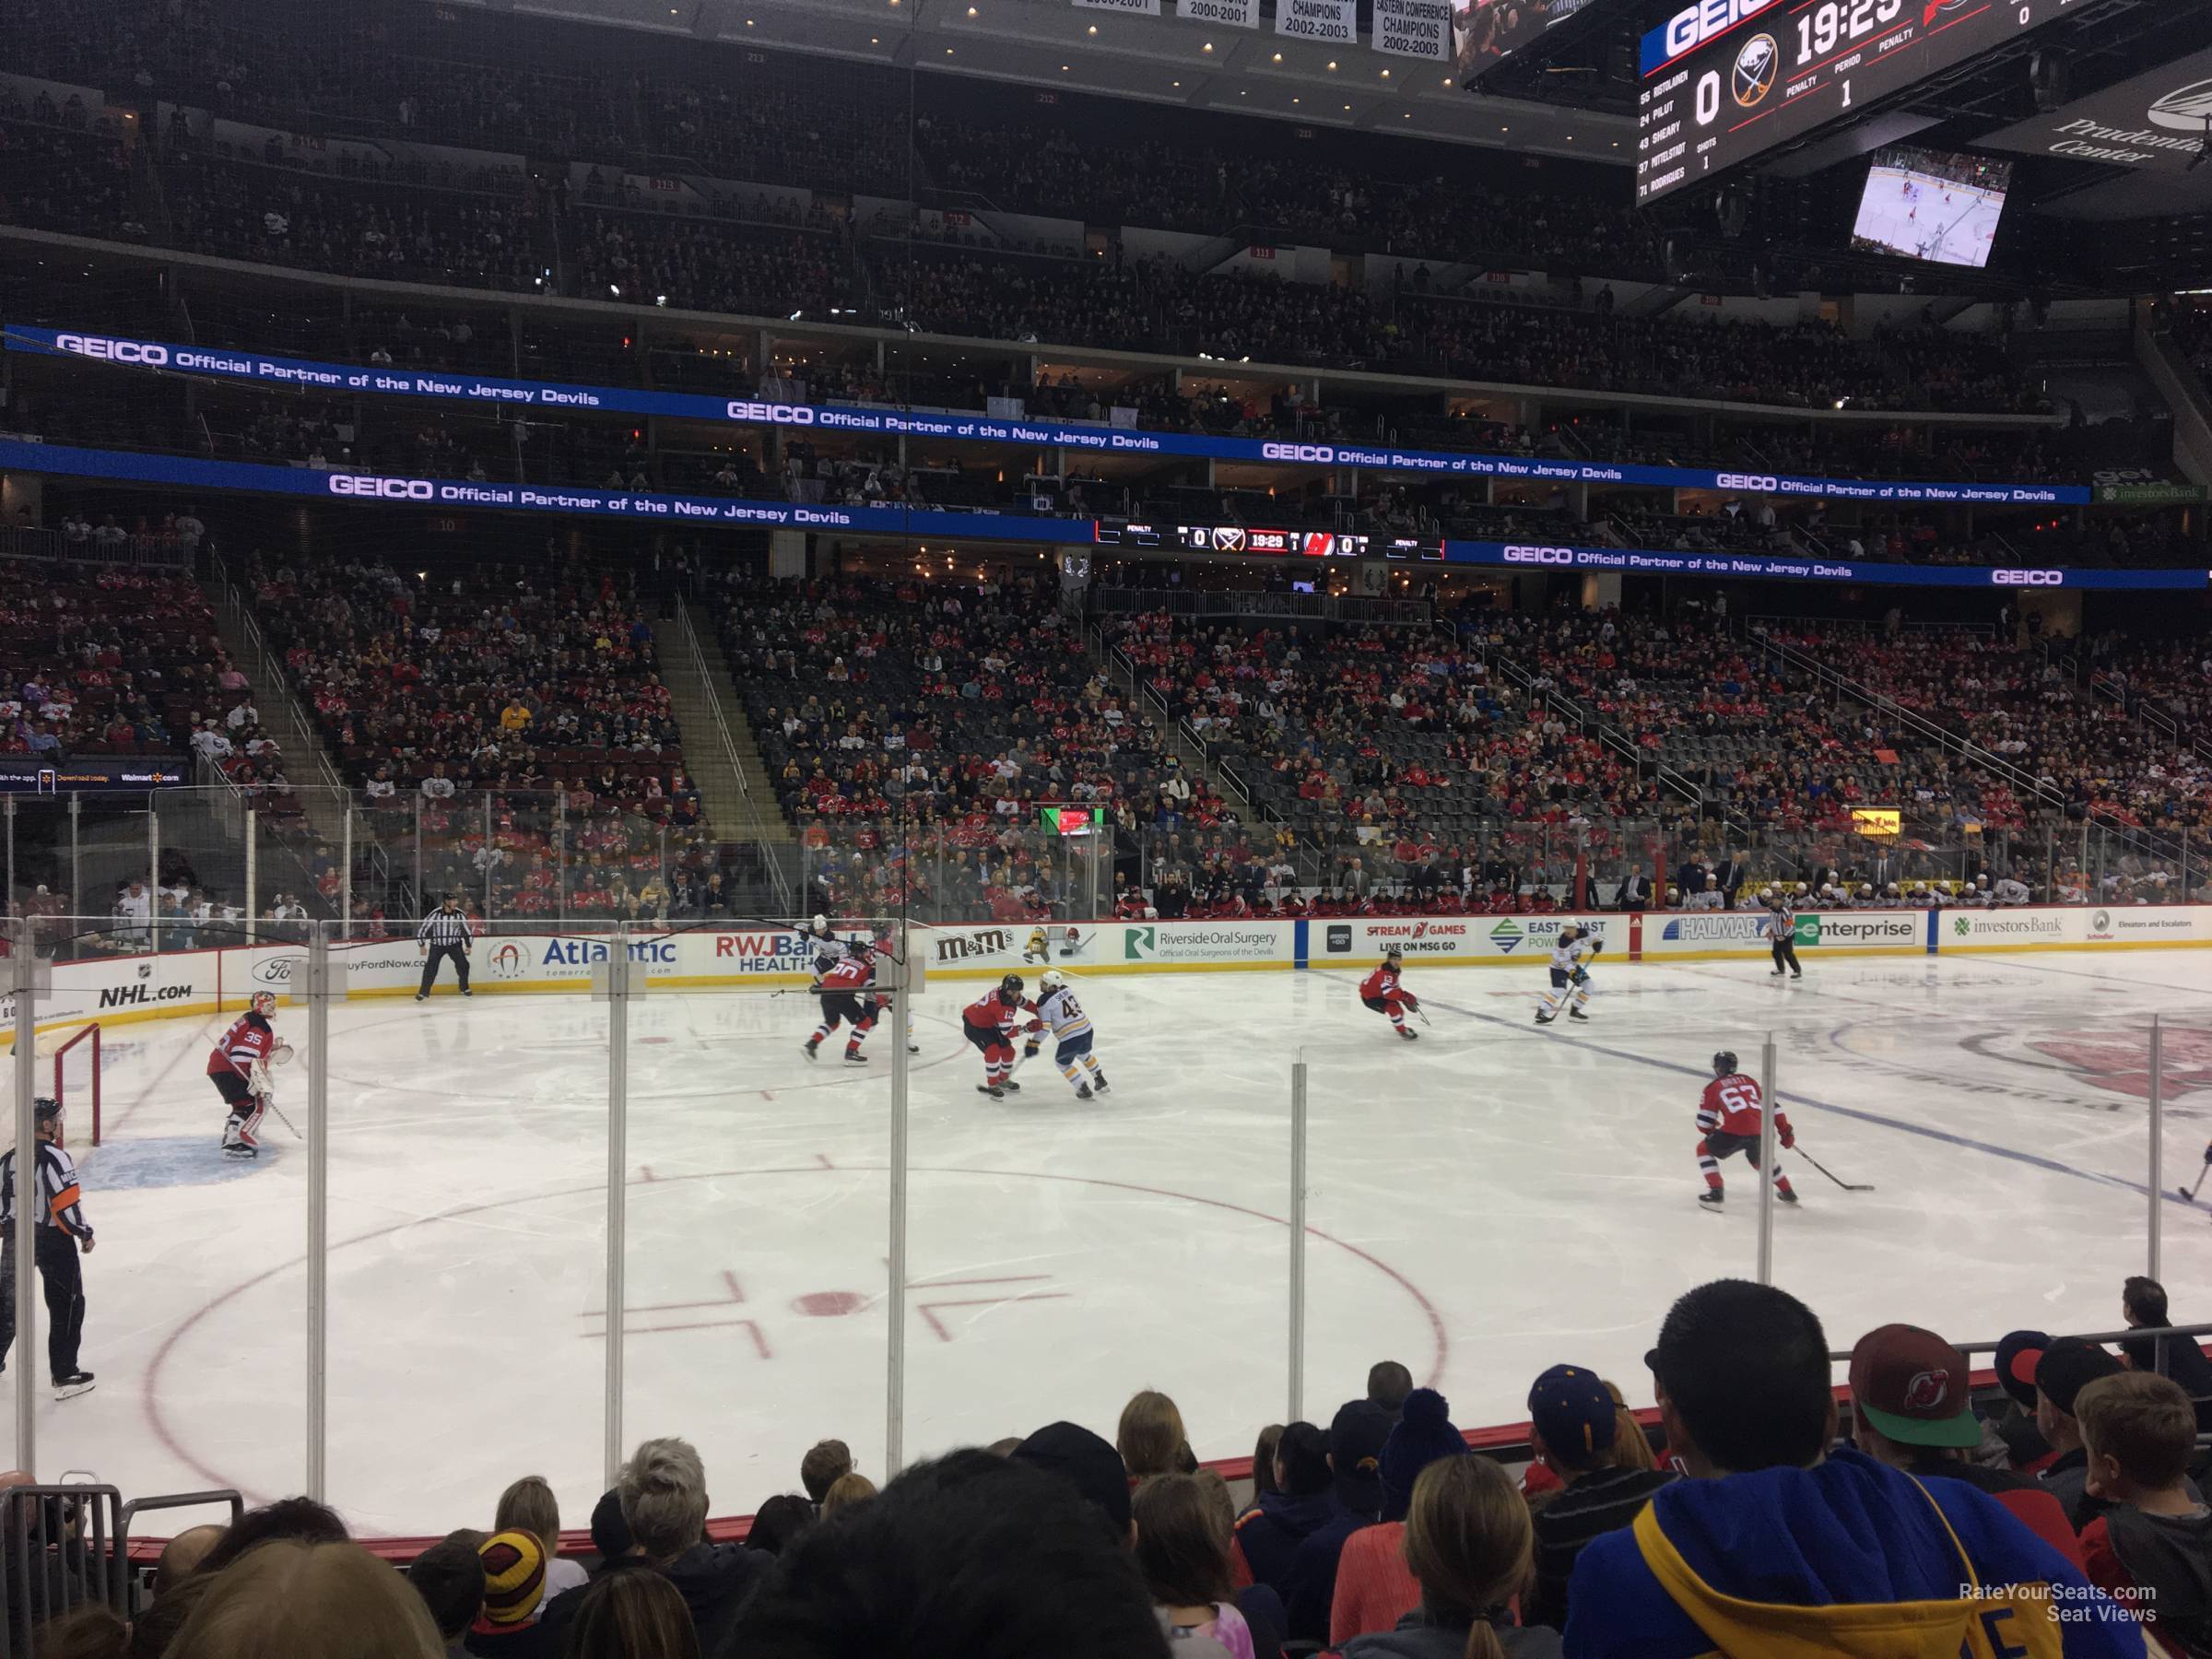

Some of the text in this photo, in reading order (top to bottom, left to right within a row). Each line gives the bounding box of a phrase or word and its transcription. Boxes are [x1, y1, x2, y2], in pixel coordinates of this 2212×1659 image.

[1191, 2, 1246, 22] 2000-2001
[1292, 1, 1341, 20] CHAMPIONS
[1406, 2, 1448, 20] CONFERENCE
[2019, 6, 2030, 25] 0
[1286, 18, 1348, 38] 2002-2003
[1383, 17, 1440, 39] CHAMPIONS
[1383, 36, 1439, 55] 2002-2003
[1878, 27, 1913, 53] PENALTY
[1835, 53, 1861, 74] PERIOD
[1786, 75, 1818, 98] PENALTY
[1841, 80, 1851, 108] 1
[1641, 90, 1651, 105] 55
[1696, 69, 1721, 126] 0
[1640, 100, 1675, 128] 24 PILUT
[1639, 120, 1681, 150] 43 SHEARY
[2053, 118, 2205, 153] Prudentia
[1697, 136, 1717, 154] SHOTS
[2049, 140, 2155, 162] Center
[1639, 160, 1649, 174] 37
[1703, 155, 1709, 170] 1
[1640, 166, 1685, 197] 71 RODRIGUES
[56, 334, 599, 406] GEICO Official Partner of the New Jersey Devils
[727, 401, 1159, 449] GEICO Official Partner of the New Jersey Devils
[1262, 442, 1622, 479] GEICO Official Partner of the New Jersey Devils
[1716, 473, 2055, 501] GEICO Official Partner of the New Jersey Devils
[329, 474, 850, 524] GEICO Official Partner of the New Jersey Devils
[1127, 524, 1152, 533] PENALTY
[1194, 530, 1206, 546] 0
[1253, 535, 1283, 547] 19:29
[1341, 537, 1353, 553] 0
[1503, 546, 1853, 577] GEICO Official Partner of the New Jersey Devils
[1992, 569, 2064, 585] GEICO
[1367, 924, 1466, 936] STREAM GAMES
[1529, 922, 1560, 933] EAST
[1680, 917, 1759, 940] HALMAR
[1802, 921, 1912, 940] enterprise
[1974, 916, 2062, 934] investorsBank
[2118, 921, 2147, 929] Elevators
[2161, 920, 2192, 928] Escalators
[1159, 932, 1277, 946] Riverside Oral Surgery
[1380, 941, 1456, 951] LIVE ON MSG GO
[1528, 936, 1559, 947] POW
[1159, 949, 1183, 958] Official
[1200, 948, 1232, 958] Surgeons
[1241, 947, 1253, 956] the
[1253, 947, 1274, 956] Devils
[347, 959, 427, 971] uyFordNow.co
[243, 1031, 263, 1045] 35
[1719, 1084, 1763, 1114] 63
